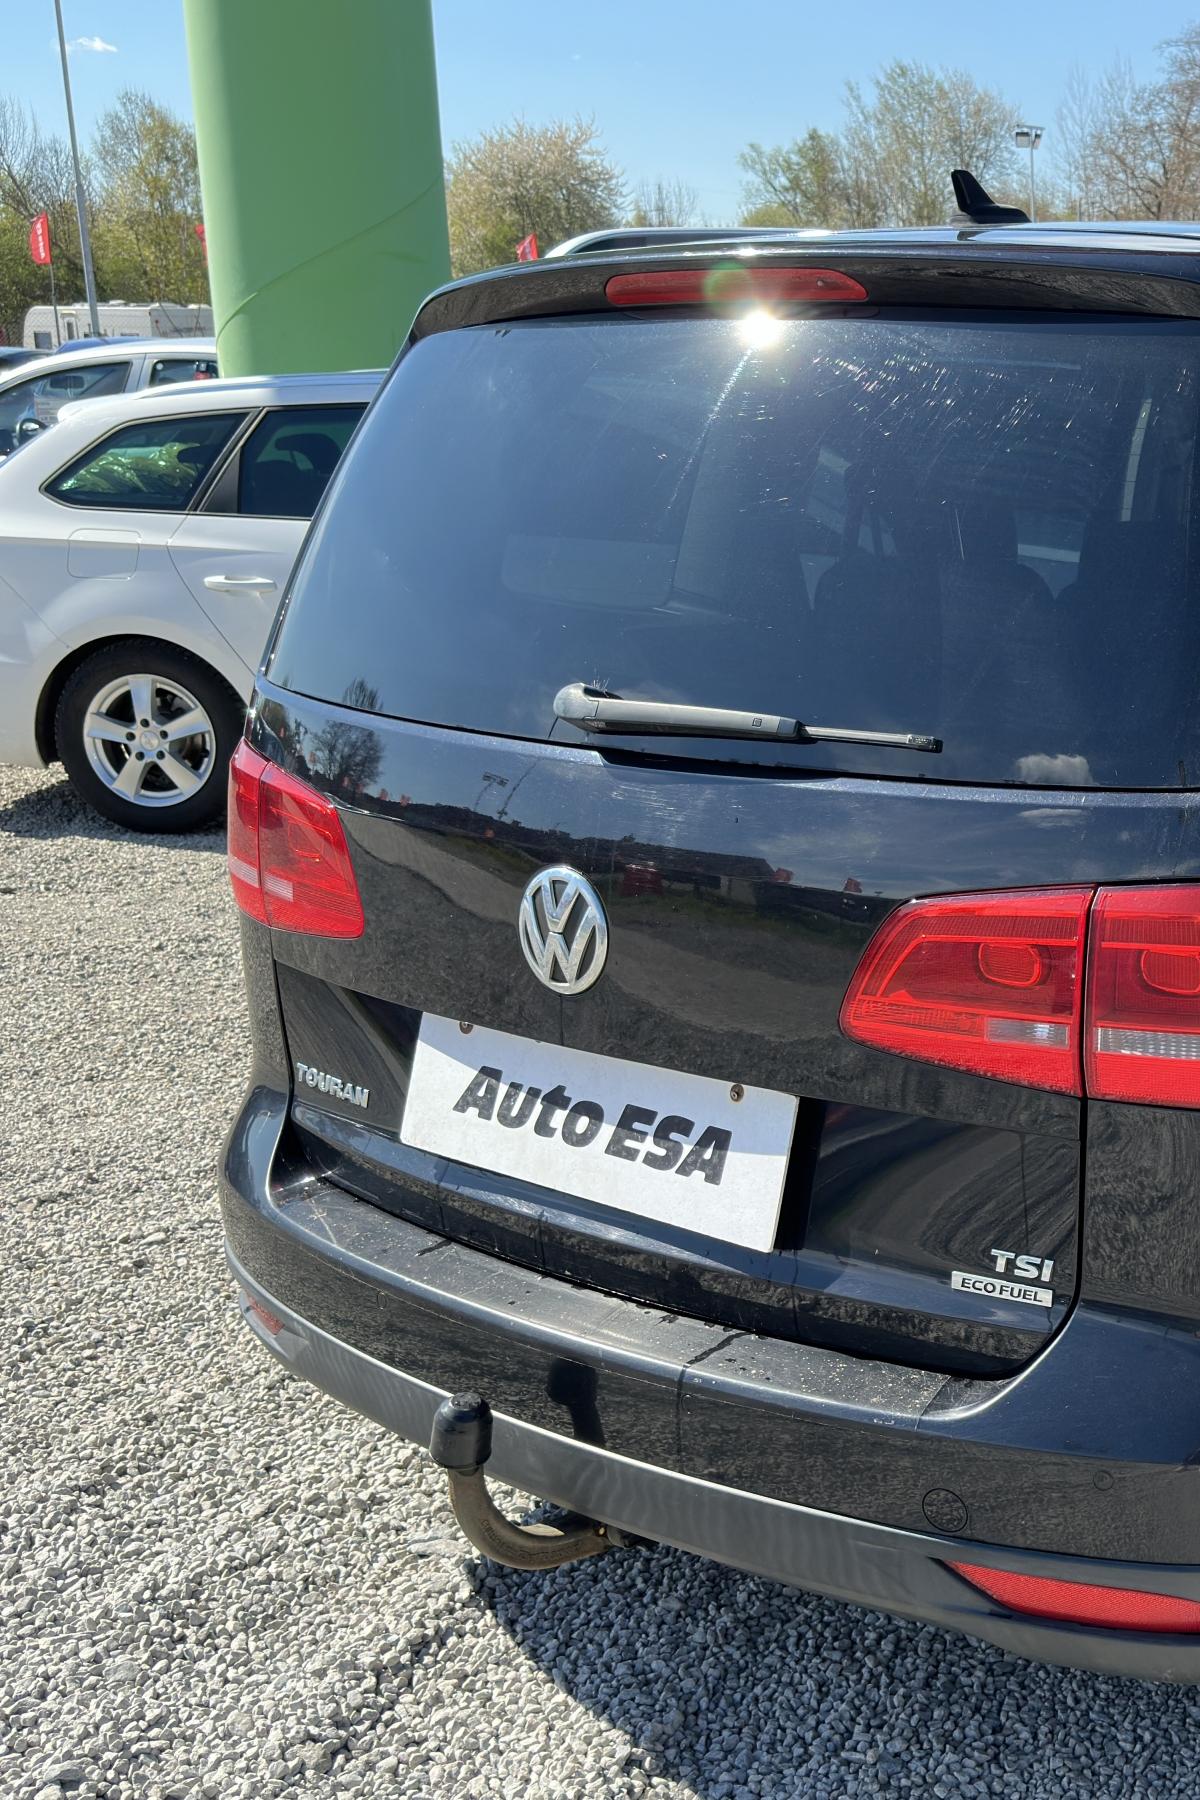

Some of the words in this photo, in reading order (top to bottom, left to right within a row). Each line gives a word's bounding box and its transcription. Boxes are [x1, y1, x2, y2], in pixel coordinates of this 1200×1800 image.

[296, 1062, 370, 1109] TOURAN
[452, 1065, 604, 1148] Auto
[604, 1103, 732, 1186] ESA
[990, 1248, 1054, 1282] TSI
